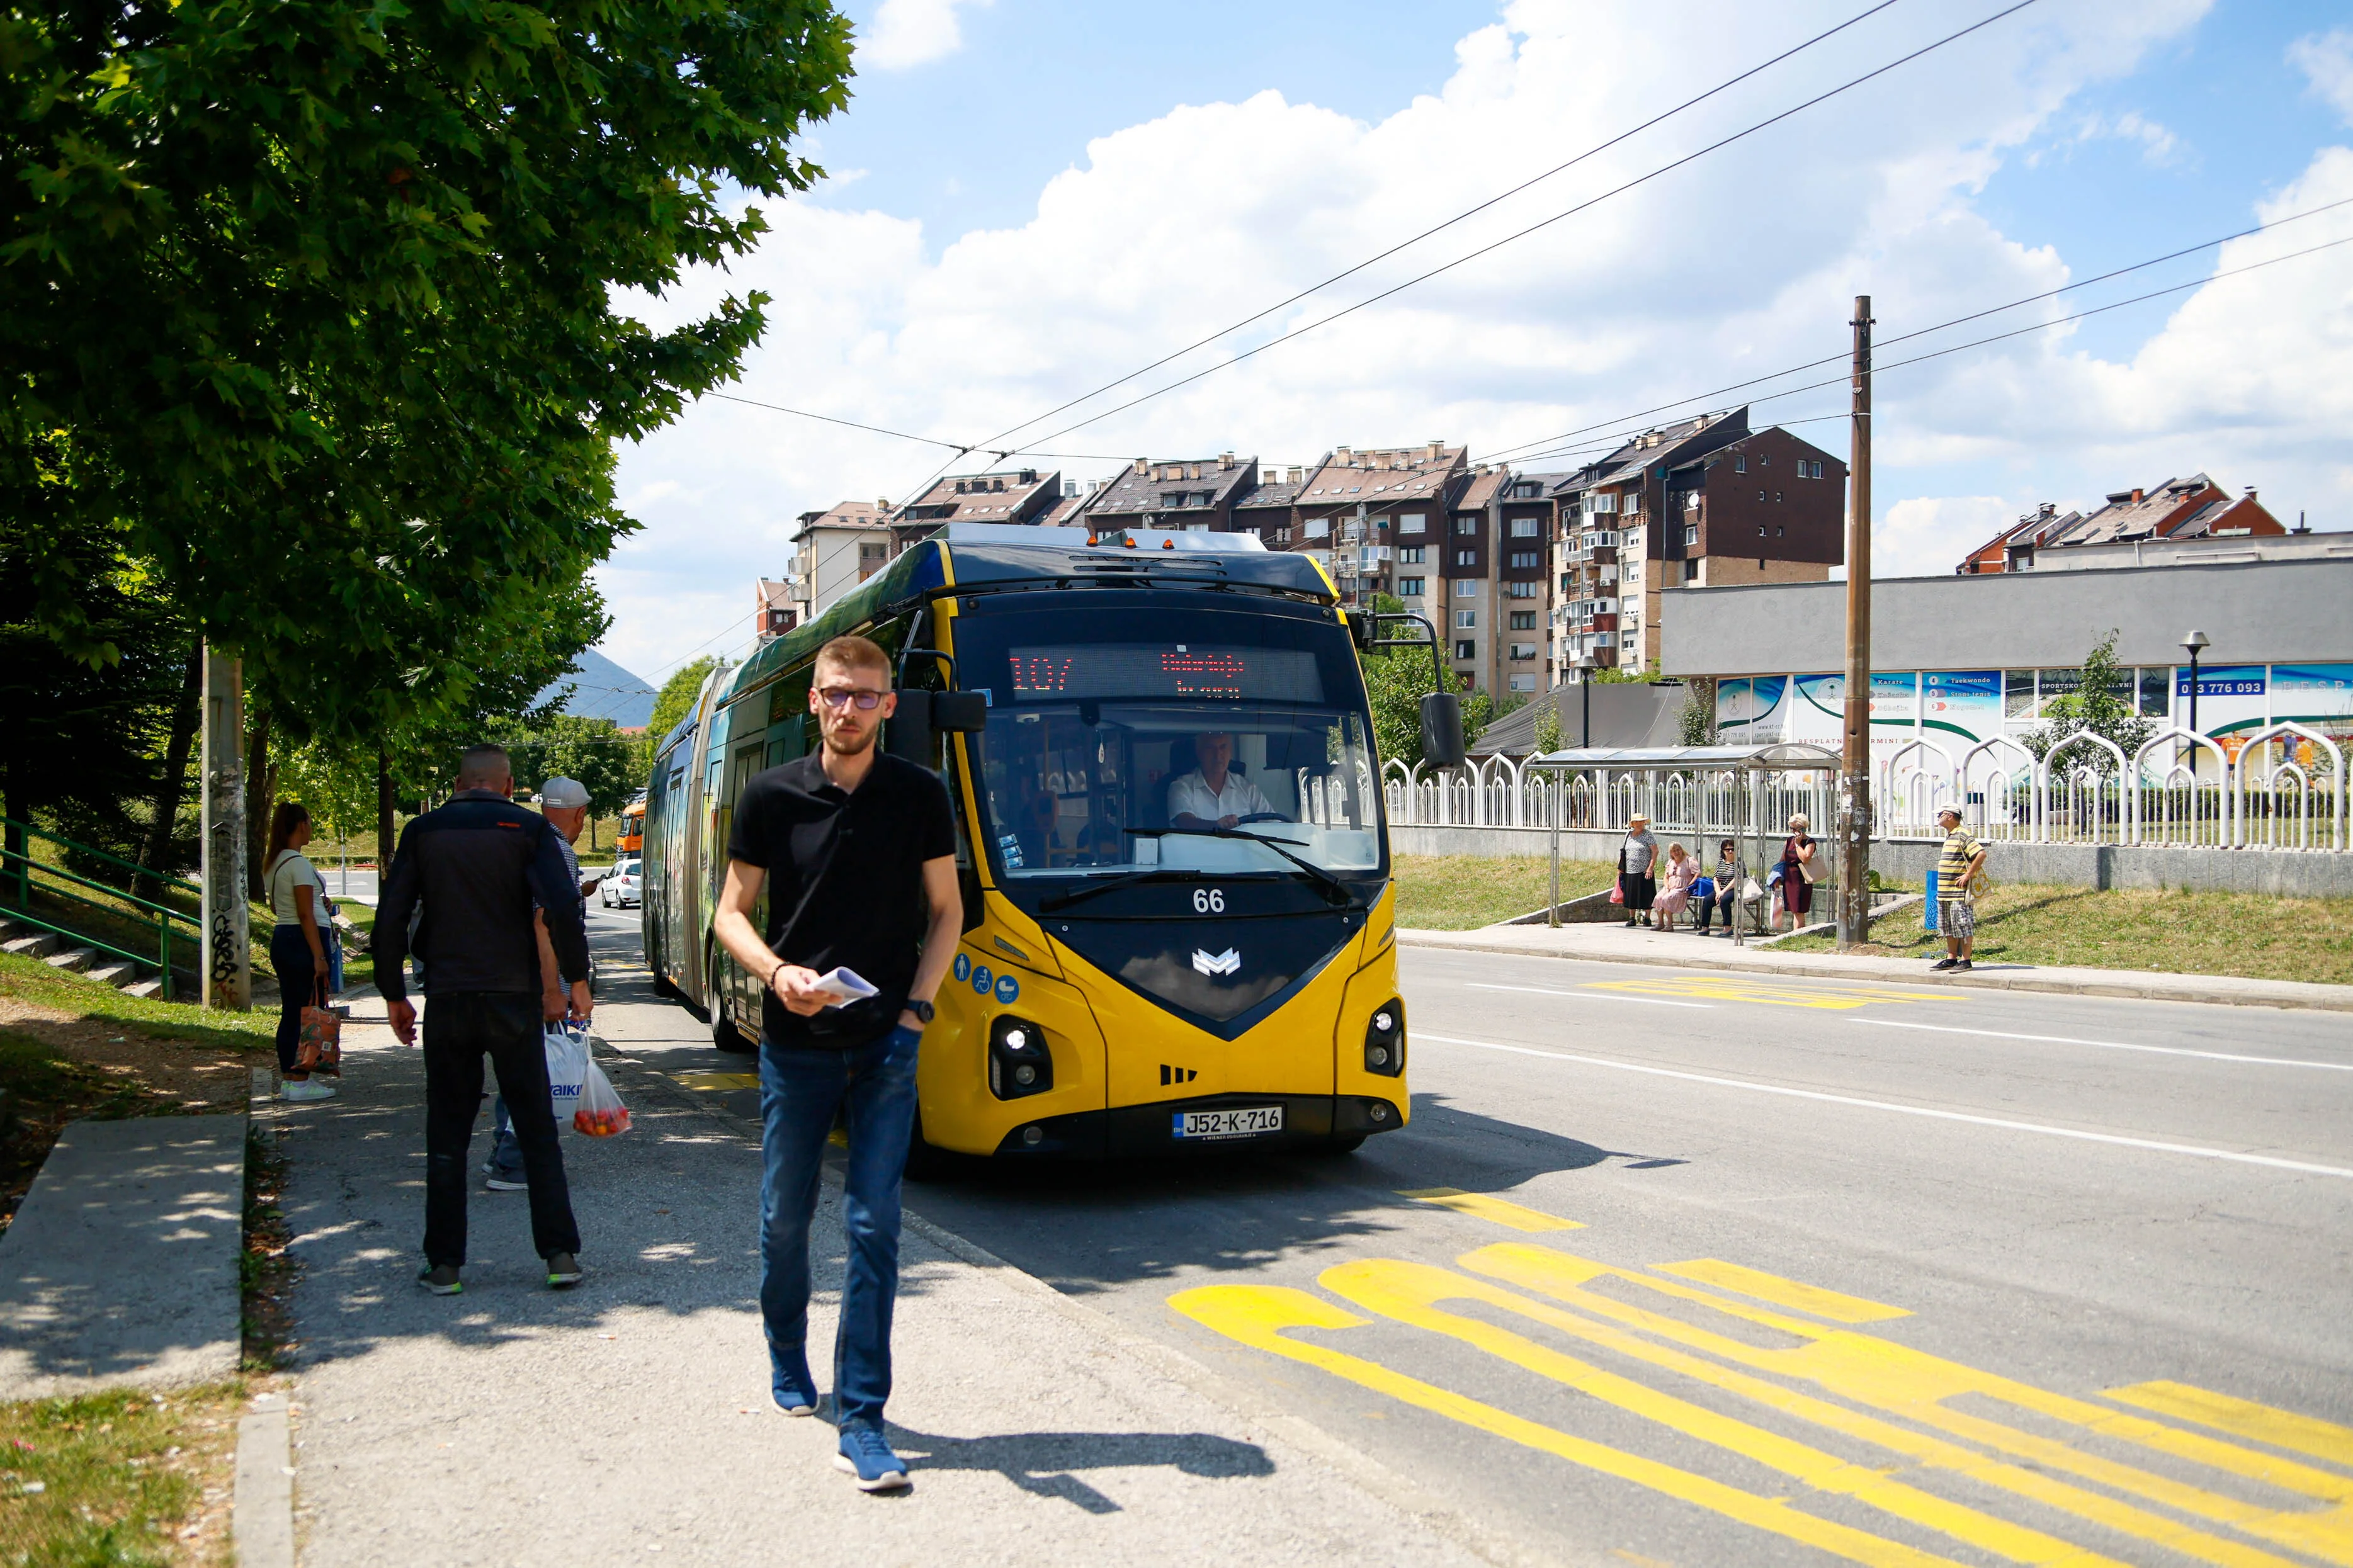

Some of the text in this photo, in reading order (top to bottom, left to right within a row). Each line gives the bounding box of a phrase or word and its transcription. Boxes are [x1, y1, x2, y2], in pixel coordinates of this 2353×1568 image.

[2209, 683, 2232, 692] 776
[2237, 682, 2261, 692] 093
[2282, 680, 2353, 692] BESP
[1193, 889, 1225, 913] 66
[1186, 1110, 1279, 1134] J52-K-716
